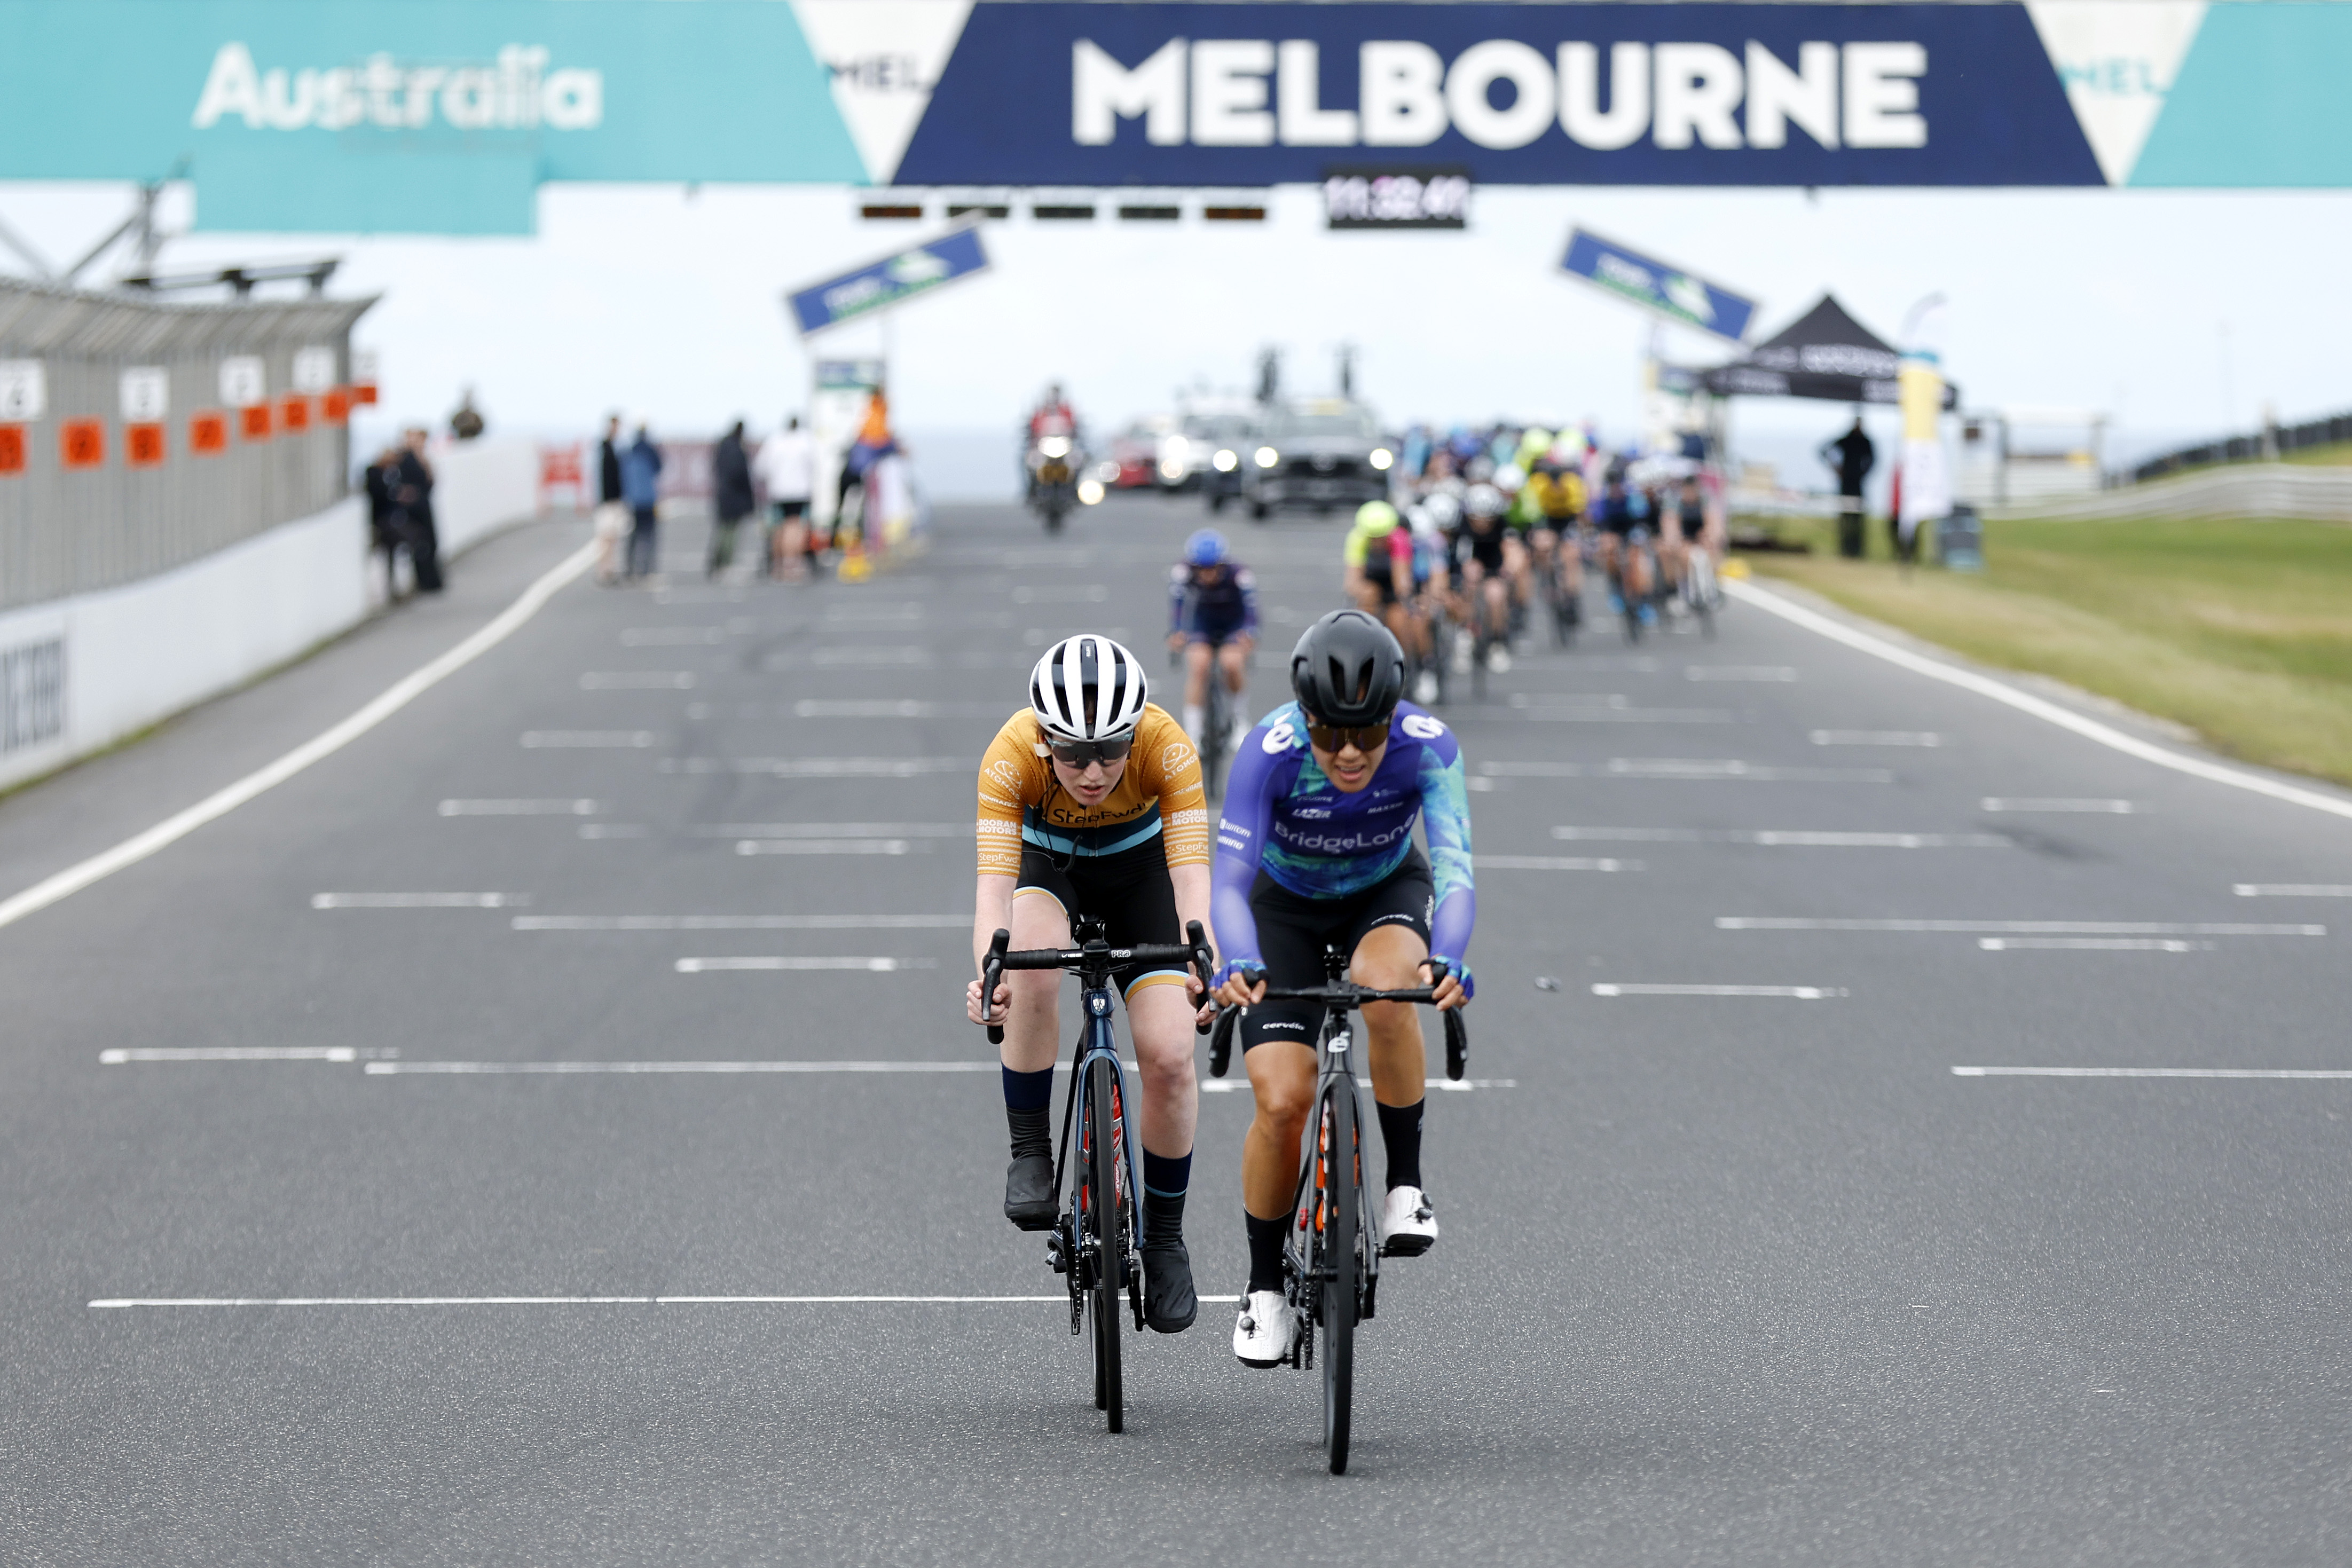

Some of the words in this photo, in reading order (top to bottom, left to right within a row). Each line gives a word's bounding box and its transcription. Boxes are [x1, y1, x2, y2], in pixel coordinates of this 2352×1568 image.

[191, 41, 603, 132] Australia
[1069, 37, 1929, 152] MELBOURNE
[984, 767, 1020, 800] ATOMOS
[979, 818, 1017, 828] BOORAN
[978, 825, 1017, 836] MOTORS
[1176, 841, 1208, 853] StepFw
[1111, 949, 1131, 958] PRO
